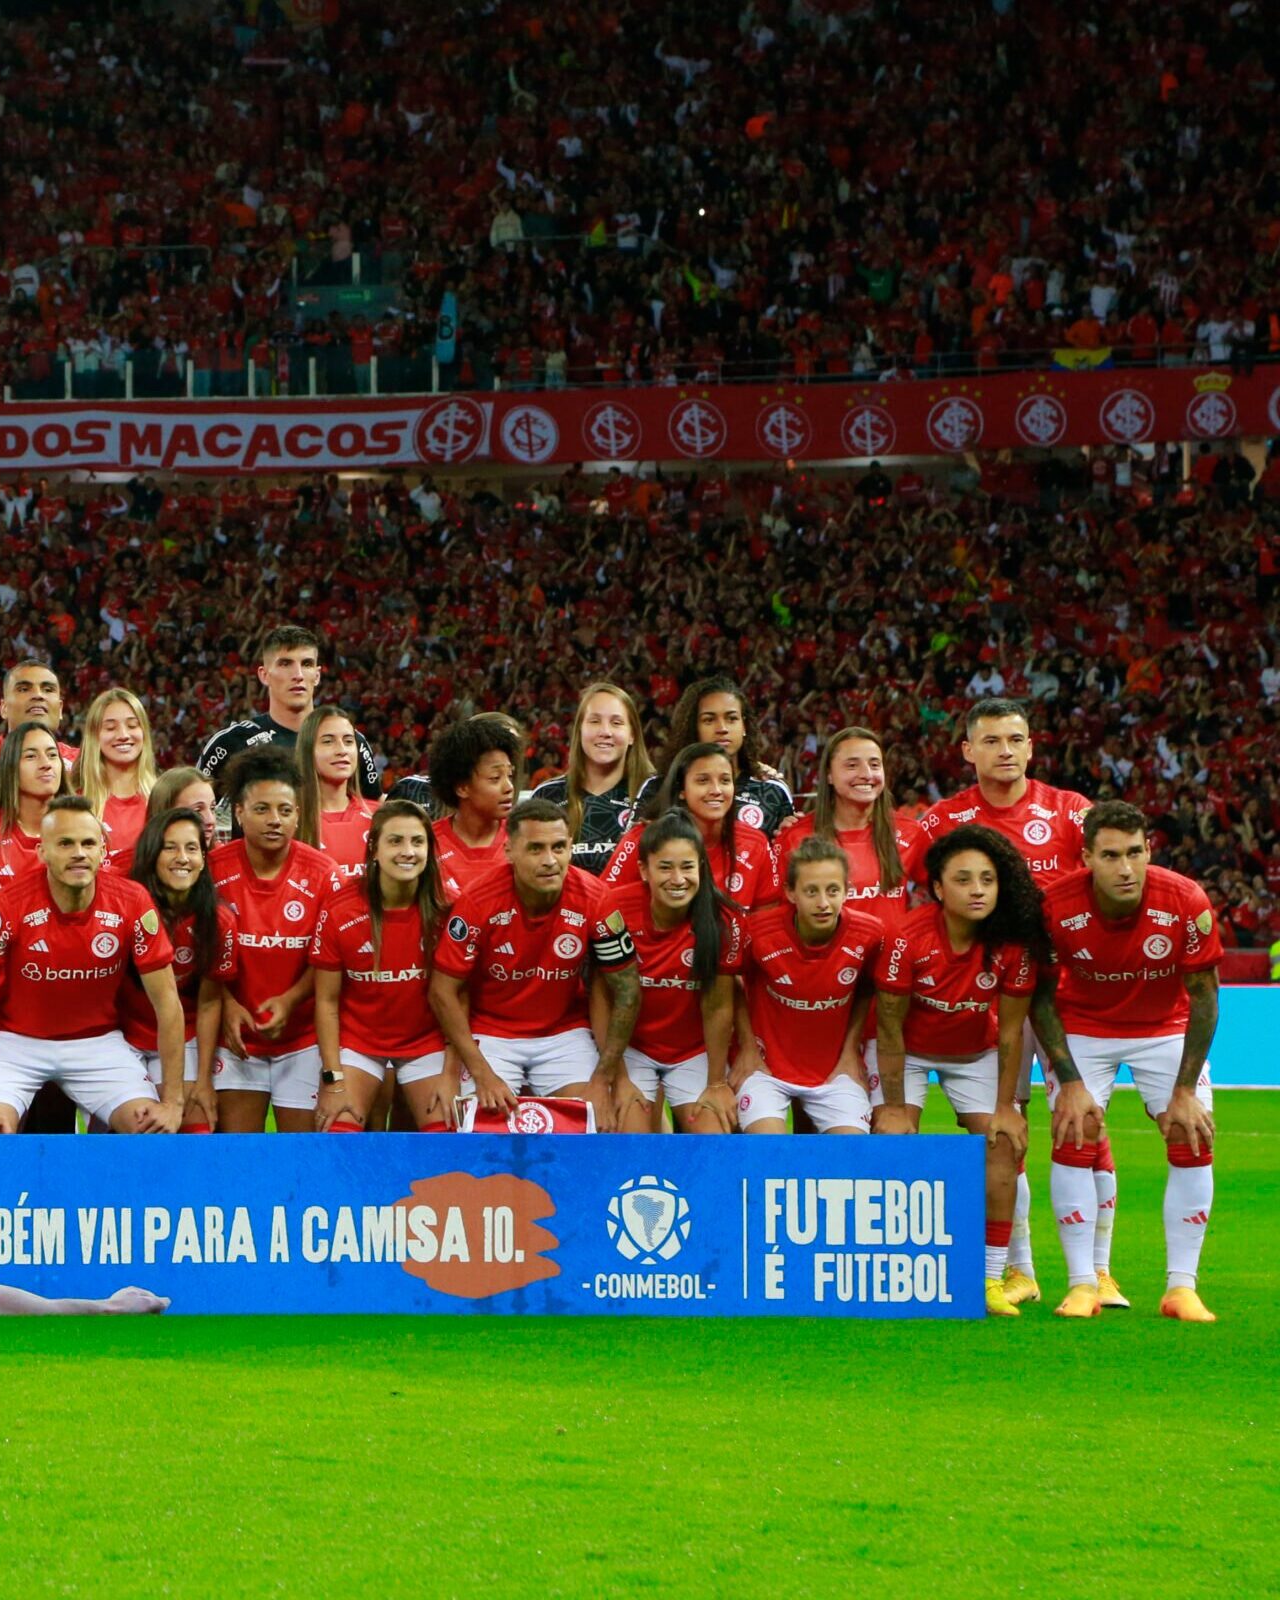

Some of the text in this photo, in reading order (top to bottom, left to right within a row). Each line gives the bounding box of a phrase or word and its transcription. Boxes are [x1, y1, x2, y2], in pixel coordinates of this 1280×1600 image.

[119, 420, 411, 471] MACACOS
[202, 755, 218, 777] ero
[359, 743, 374, 772] vero
[572, 842, 602, 854] RELA
[606, 852, 628, 883] vero
[1027, 855, 1058, 873] isul
[23, 907, 51, 924] ESTRELA
[1060, 911, 1092, 928] ESTRELA
[1147, 908, 1180, 922] ESTRELA
[237, 932, 312, 949] RELA BET
[312, 923, 323, 955] vero
[45, 960, 122, 981] banrisul
[348, 969, 408, 983] ESTRELA
[887, 950, 901, 982] vero
[1094, 964, 1176, 982] banrisul
[764, 1178, 953, 1246] FUTEBOL
[77, 1207, 132, 1265] VAI
[144, 1206, 257, 1264] PARA
[270, 1206, 290, 1263] A
[302, 1204, 470, 1264] CAMISA
[483, 1206, 525, 1264] 10.
[764, 1244, 953, 1303] É FUTEBOL
